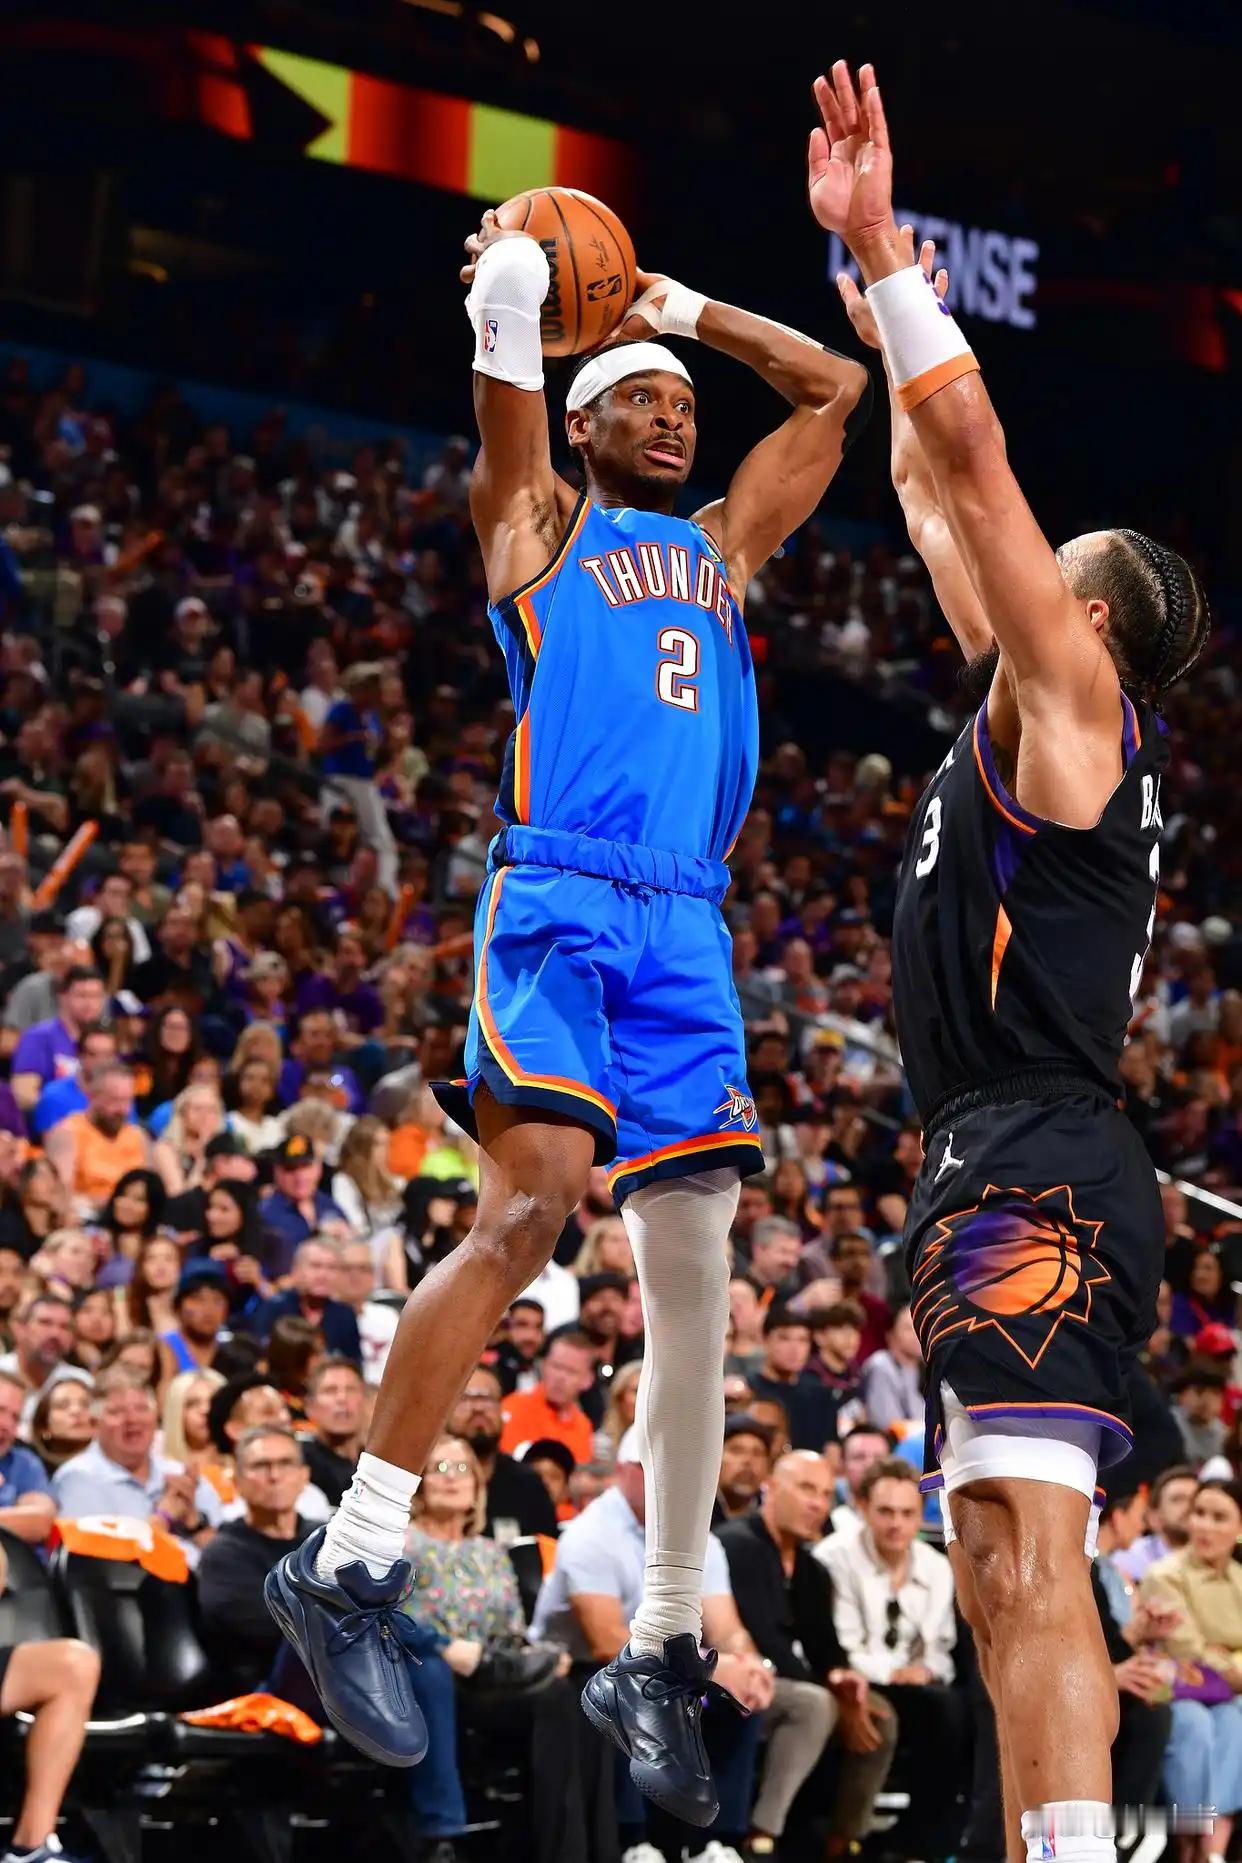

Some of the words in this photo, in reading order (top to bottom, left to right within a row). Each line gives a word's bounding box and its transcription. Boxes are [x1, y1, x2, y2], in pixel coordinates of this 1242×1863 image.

[578, 541, 735, 648] THUNDER
[656, 626, 700, 713] 2
[914, 796, 942, 880] 3
